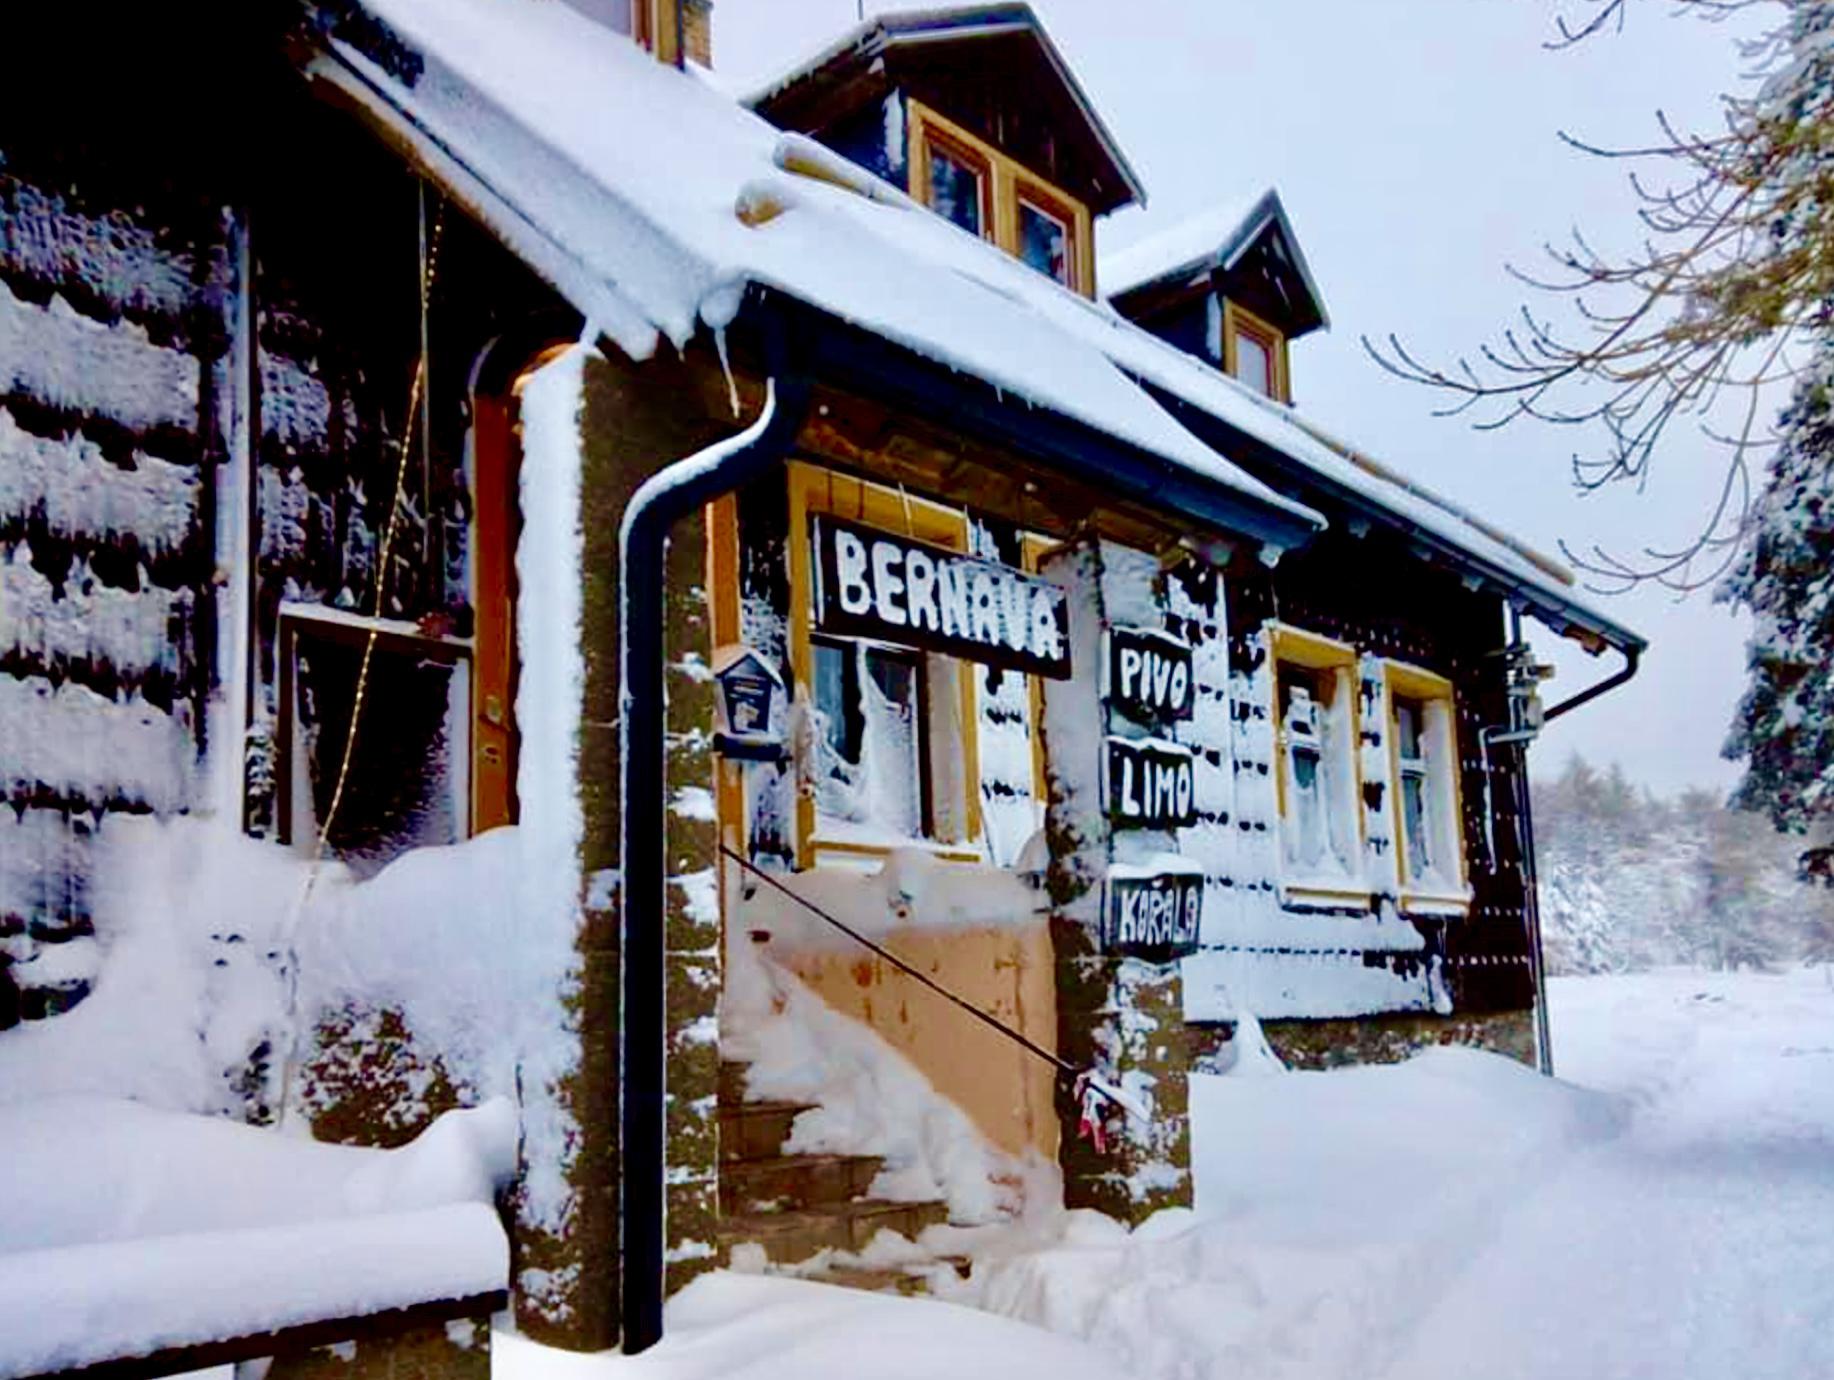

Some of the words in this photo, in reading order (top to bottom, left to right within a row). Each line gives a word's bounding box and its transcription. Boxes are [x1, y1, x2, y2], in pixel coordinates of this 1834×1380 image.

[835, 528, 1063, 661] BERNAVA
[1120, 648, 1188, 710] PIVO
[1121, 756, 1190, 819] LIMO
